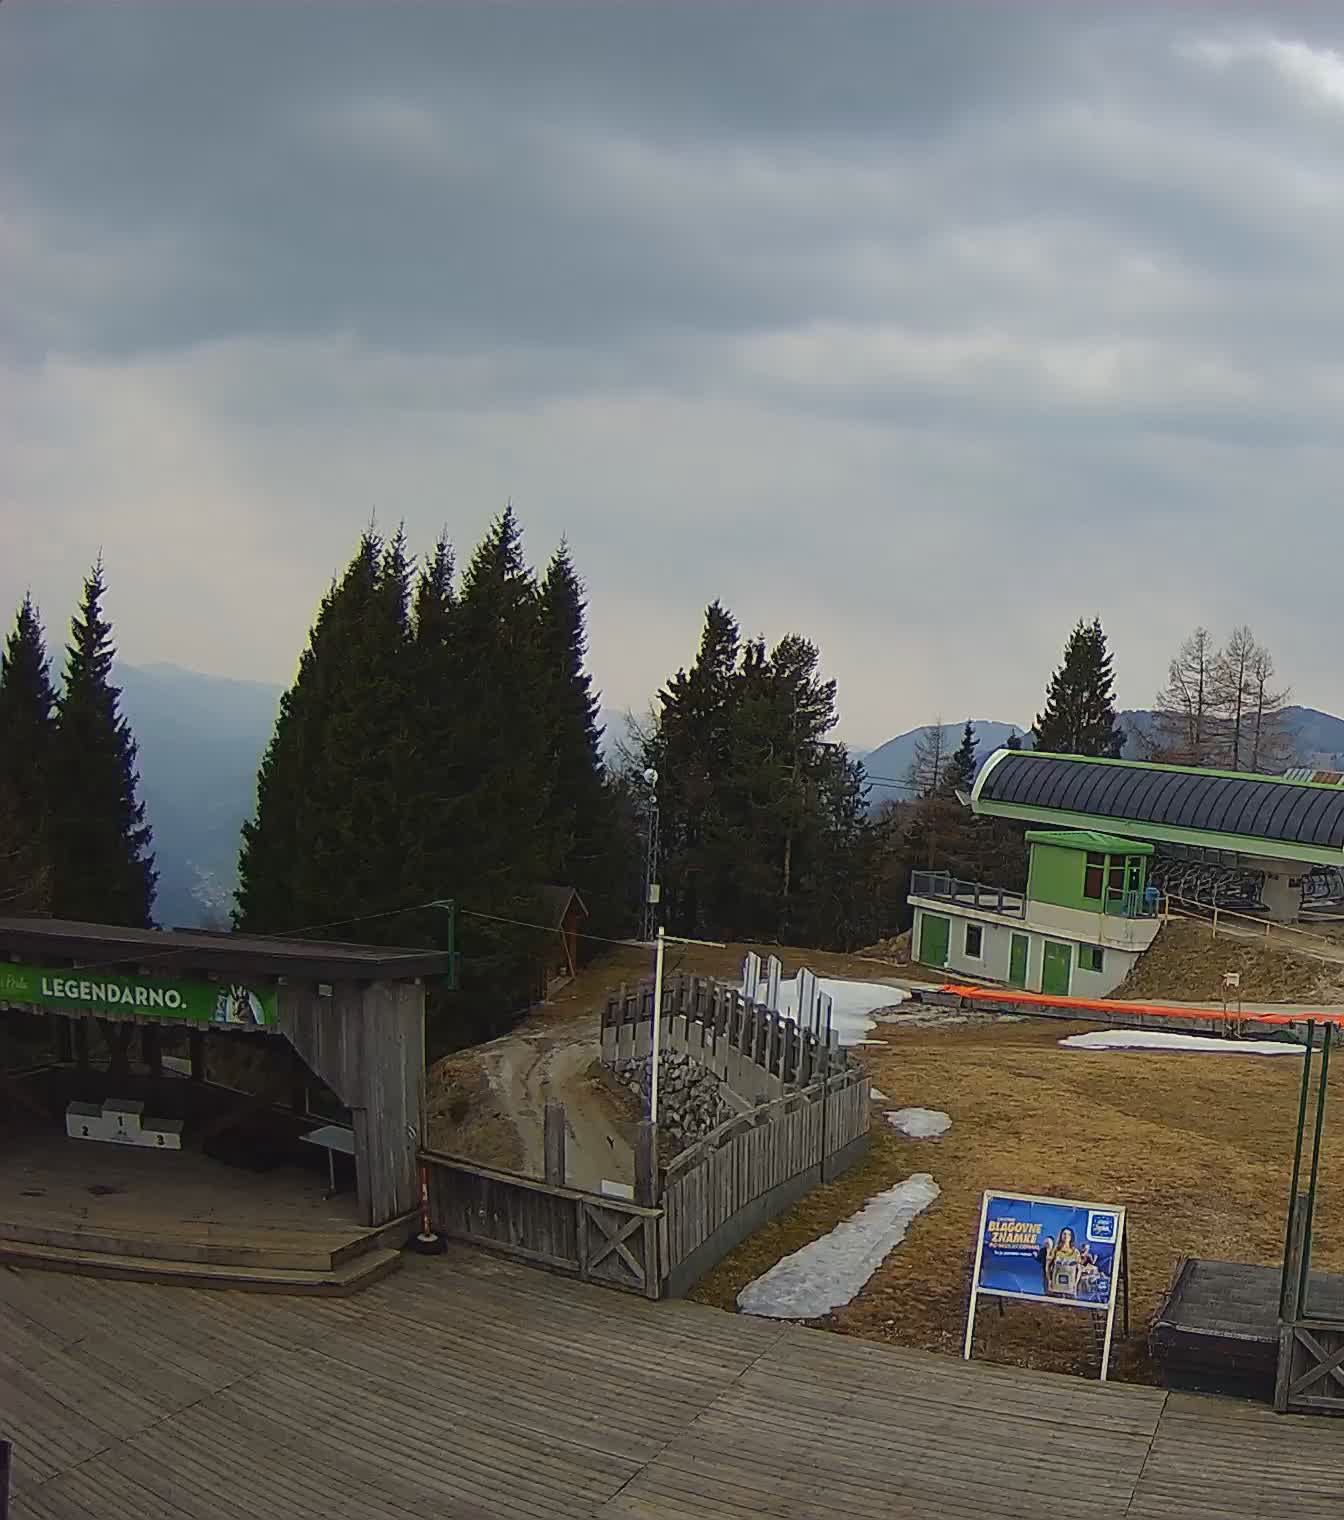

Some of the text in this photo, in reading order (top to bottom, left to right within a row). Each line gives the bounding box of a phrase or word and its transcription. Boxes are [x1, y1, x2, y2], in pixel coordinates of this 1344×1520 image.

[41, 976, 188, 1010] LEGENDARNO.
[117, 1115, 124, 1127] 1
[81, 1125, 89, 1137] 2
[155, 1134, 166, 1146] 3
[988, 1220, 1043, 1234] BLAGOVNE
[990, 1231, 1038, 1244] ZNAMKE
